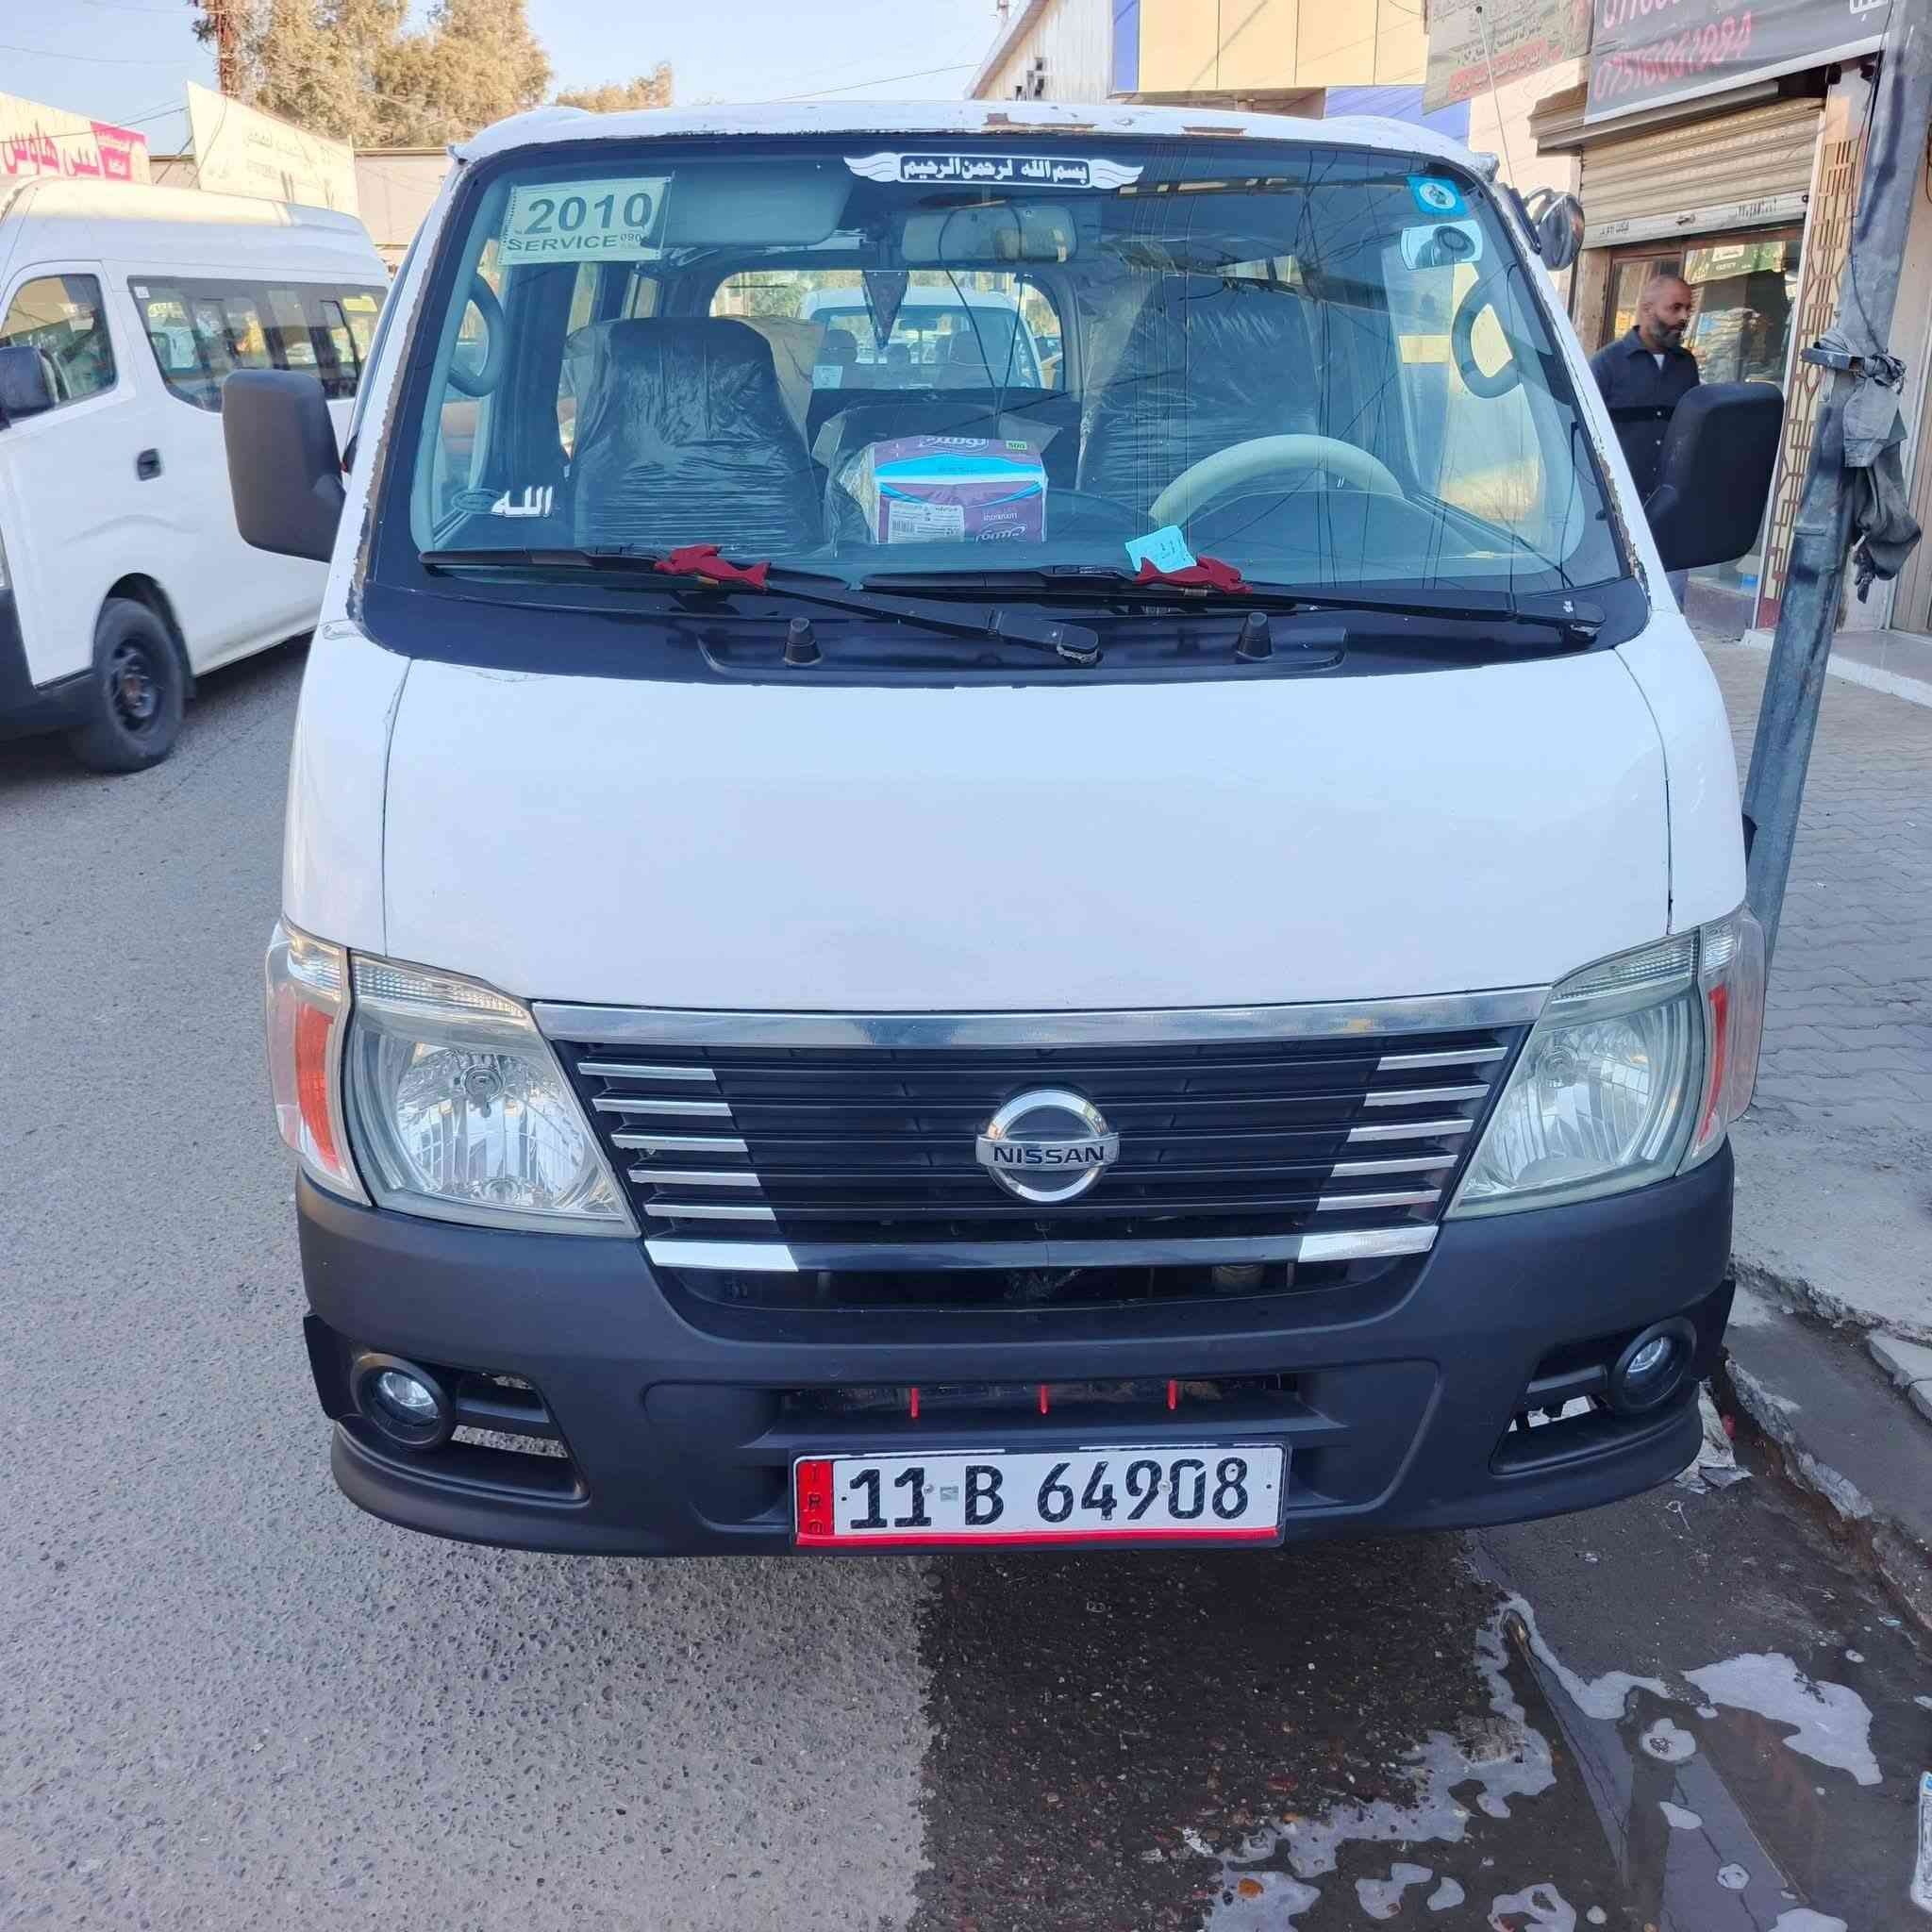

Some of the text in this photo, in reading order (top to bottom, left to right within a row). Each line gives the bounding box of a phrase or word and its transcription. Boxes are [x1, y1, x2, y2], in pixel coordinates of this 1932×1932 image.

[904, 157, 960, 179] الرحيم
[1022, 158, 1051, 178] الله
[1053, 165, 1088, 183] بسم
[525, 192, 653, 235] 2010
[507, 235, 620, 252] SERVICE
[491, 486, 553, 517] الله
[993, 1146, 1105, 1164] NISSAN
[850, 1457, 1248, 1529] 11 B 64908
